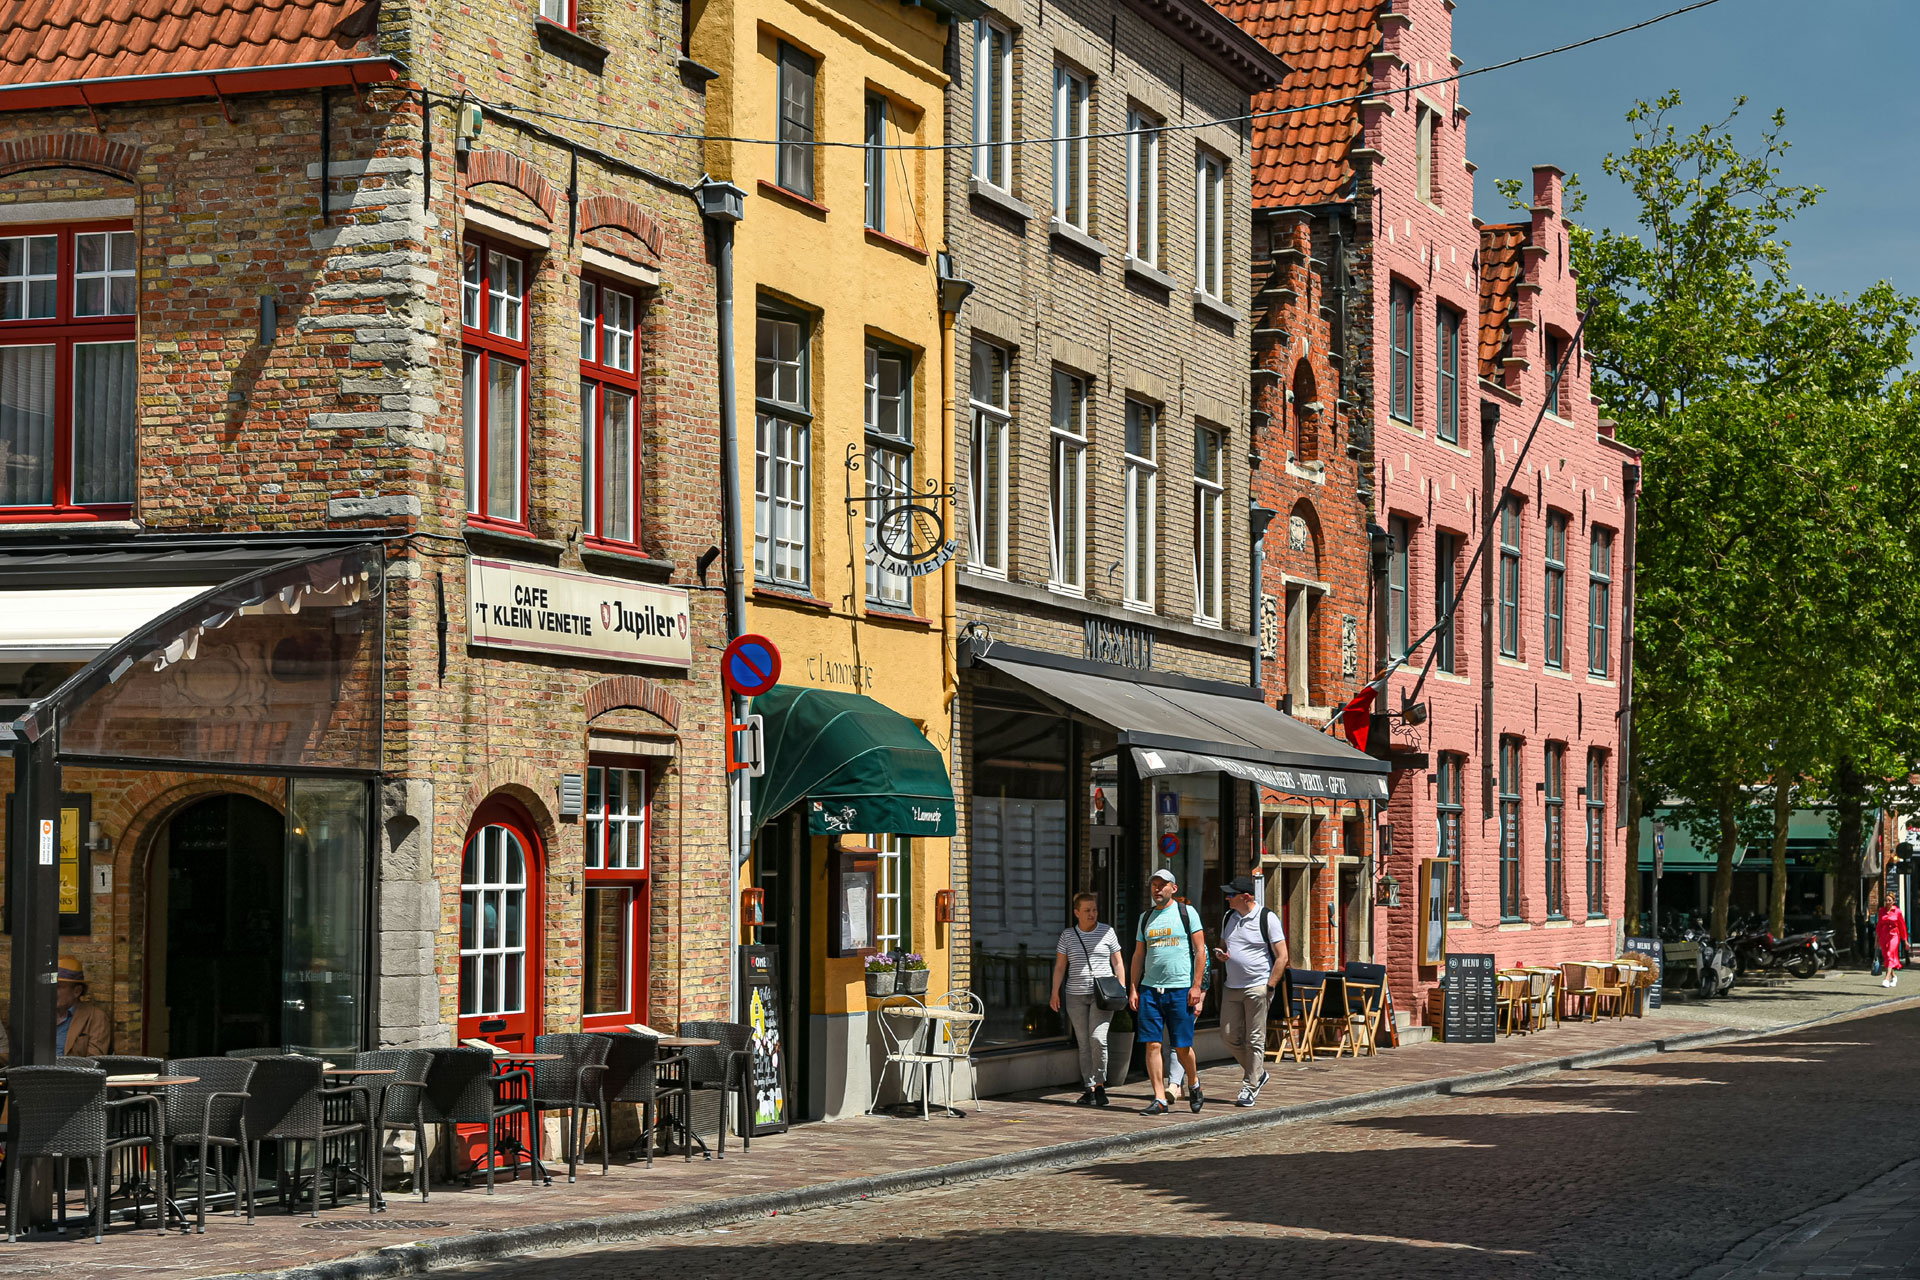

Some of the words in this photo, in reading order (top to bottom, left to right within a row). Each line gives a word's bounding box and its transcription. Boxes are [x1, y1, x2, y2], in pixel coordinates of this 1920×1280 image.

[879, 541, 956, 576] LAMMETJE
[514, 584, 549, 608] CAFE
[475, 602, 488, 624] 'T
[493, 605, 532, 629] KLEIN
[537, 610, 592, 636] VENETIE
[613, 600, 676, 641] Jupiler
[1328, 776, 1347, 795] GIFTS
[100, 871, 106, 887] 1
[1636, 941, 1651, 950] MENU
[1461, 958, 1480, 968] MENU
